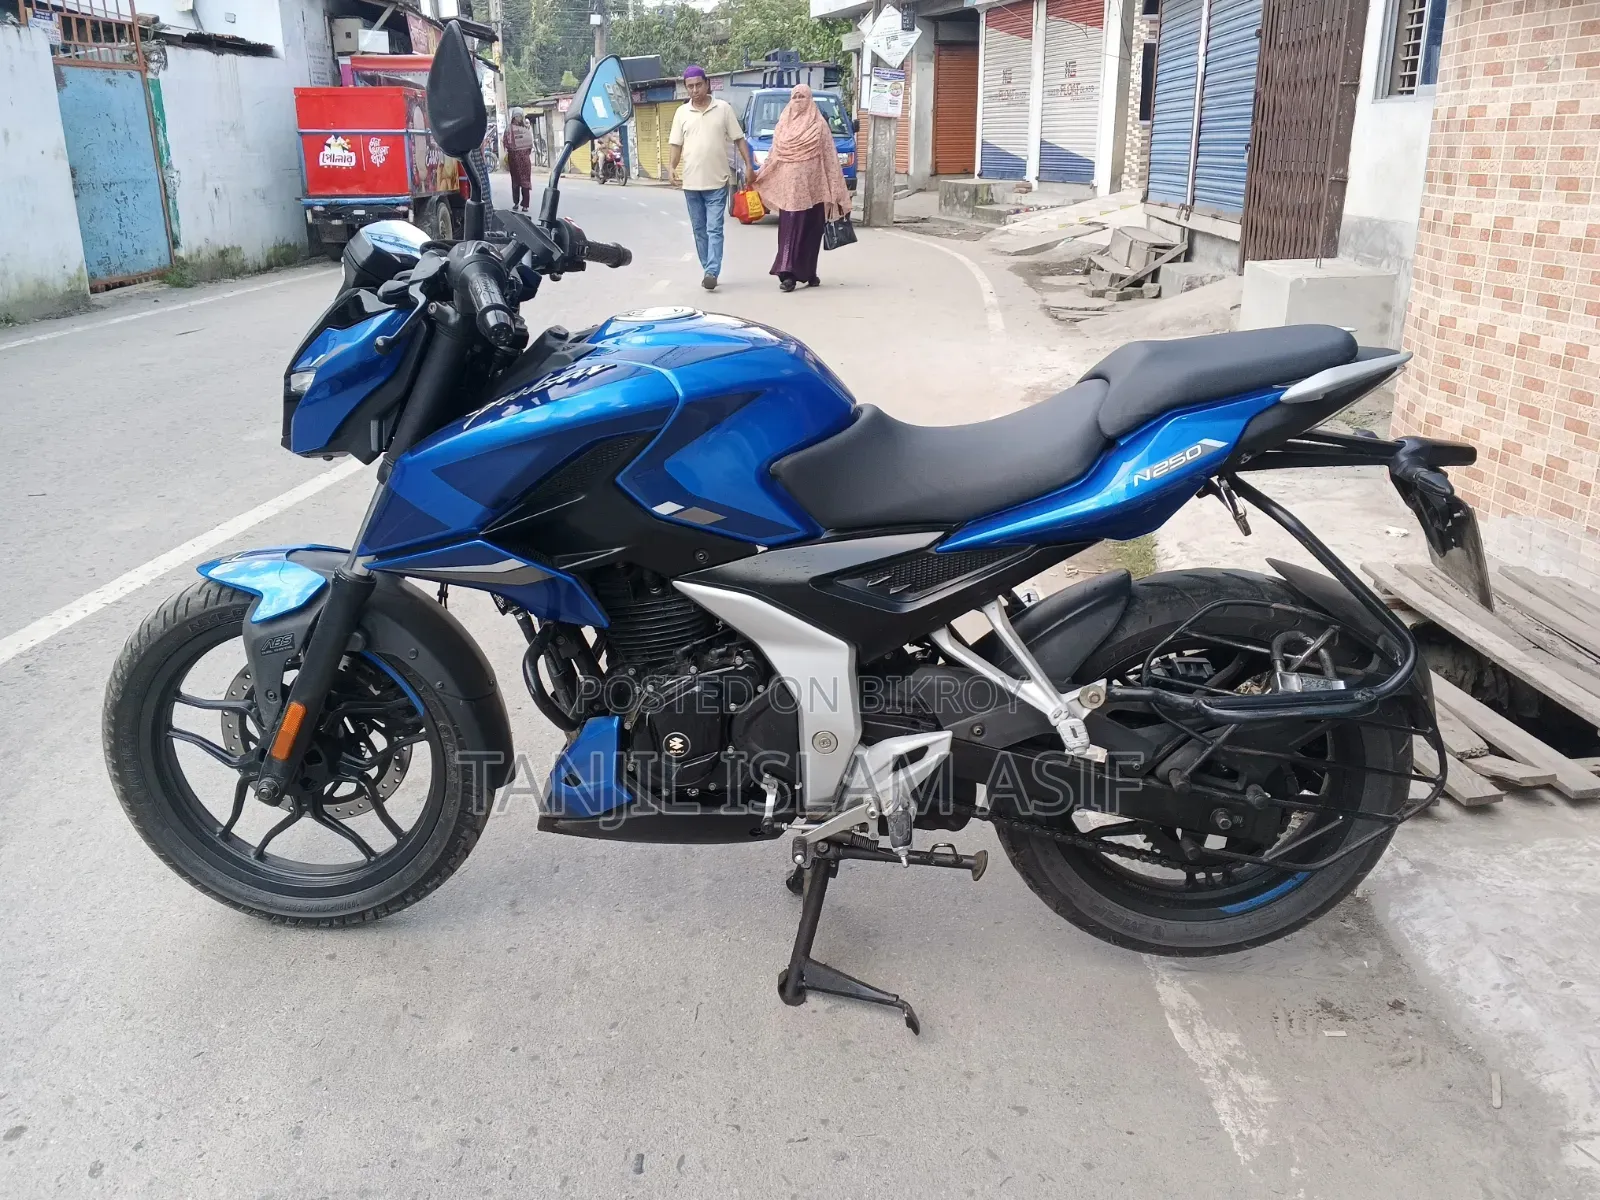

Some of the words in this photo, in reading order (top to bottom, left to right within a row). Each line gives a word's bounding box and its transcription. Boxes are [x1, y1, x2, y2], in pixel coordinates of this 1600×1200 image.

[321, 152, 354, 166] পোলার
[1133, 444, 1202, 487] N250
[261, 634, 293, 651] ABS
